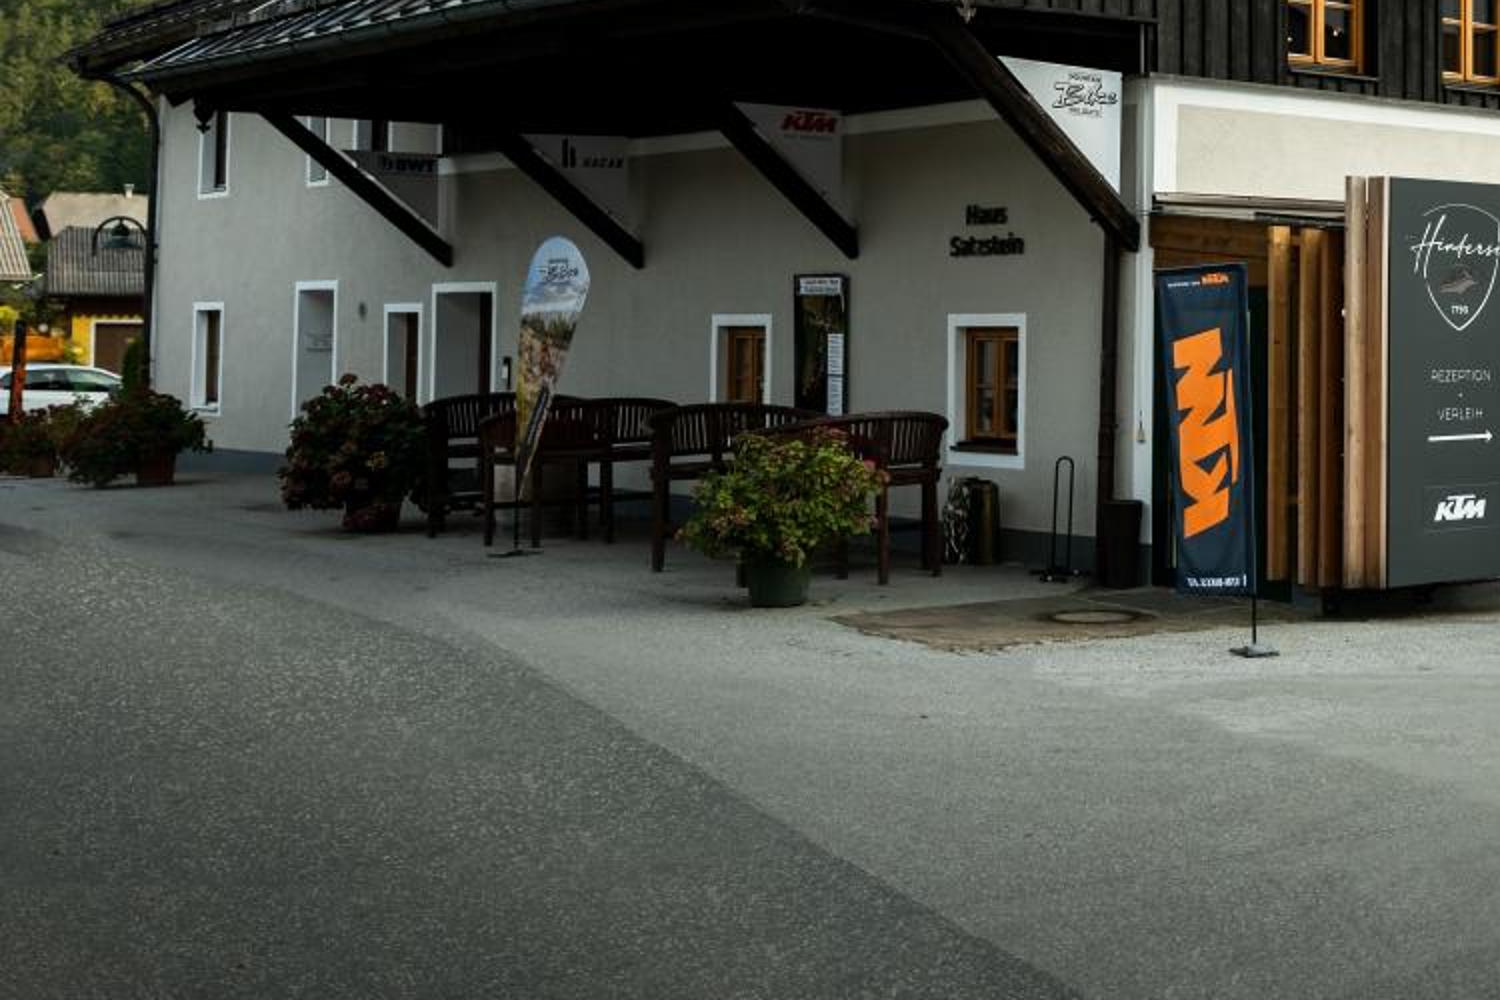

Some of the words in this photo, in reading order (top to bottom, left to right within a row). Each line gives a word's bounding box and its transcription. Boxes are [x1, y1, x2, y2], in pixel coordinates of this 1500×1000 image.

[781, 110, 836, 132] KTM
[966, 204, 1008, 225] Haus
[1431, 369, 1491, 382] REZEPTION
[1437, 407, 1483, 421] VERLEIH
[1173, 328, 1240, 539] KTM
[1434, 494, 1487, 521] KTM
